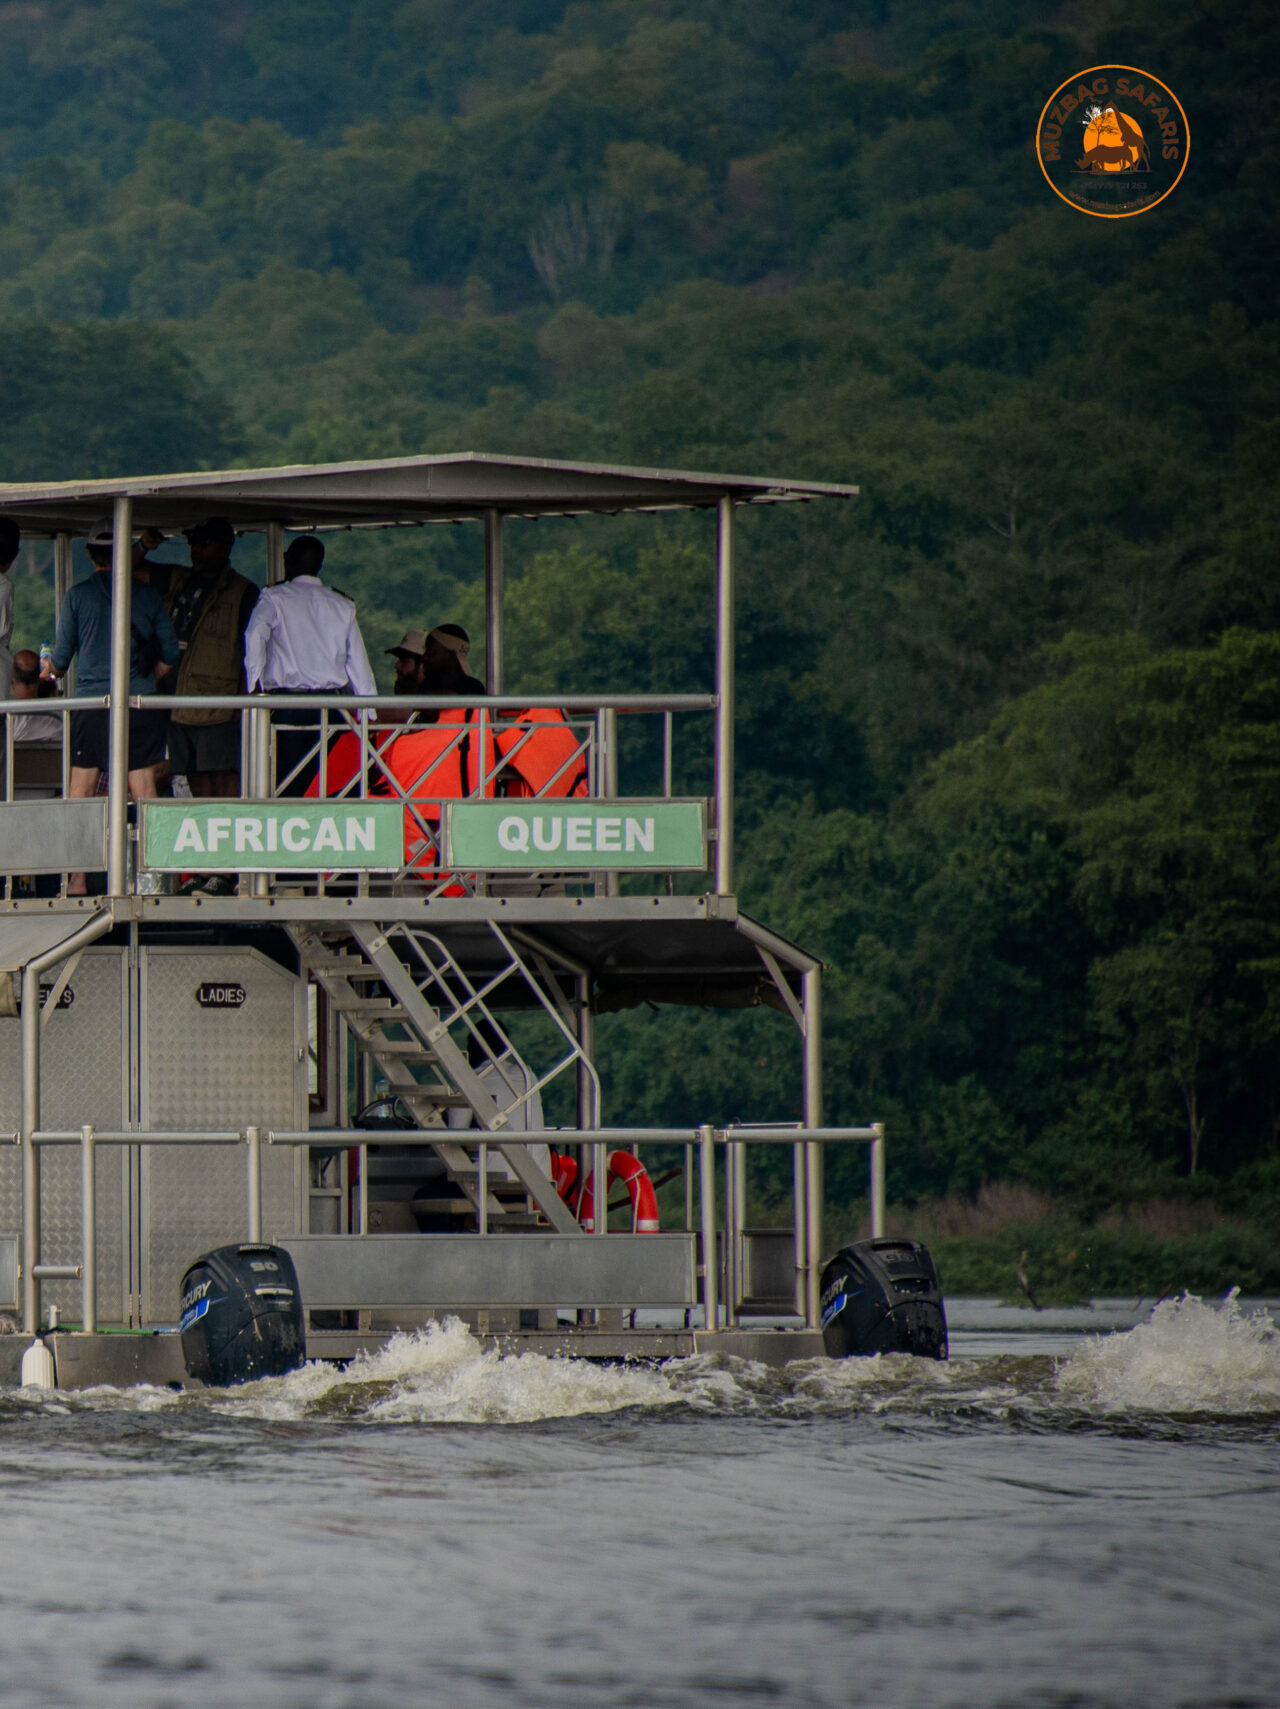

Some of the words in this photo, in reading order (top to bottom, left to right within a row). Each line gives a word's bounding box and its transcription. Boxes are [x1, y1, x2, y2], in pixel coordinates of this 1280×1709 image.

[173, 816, 376, 852] AFRICAN
[497, 816, 655, 854] QUEEN
[199, 988, 245, 1003] LADIES
